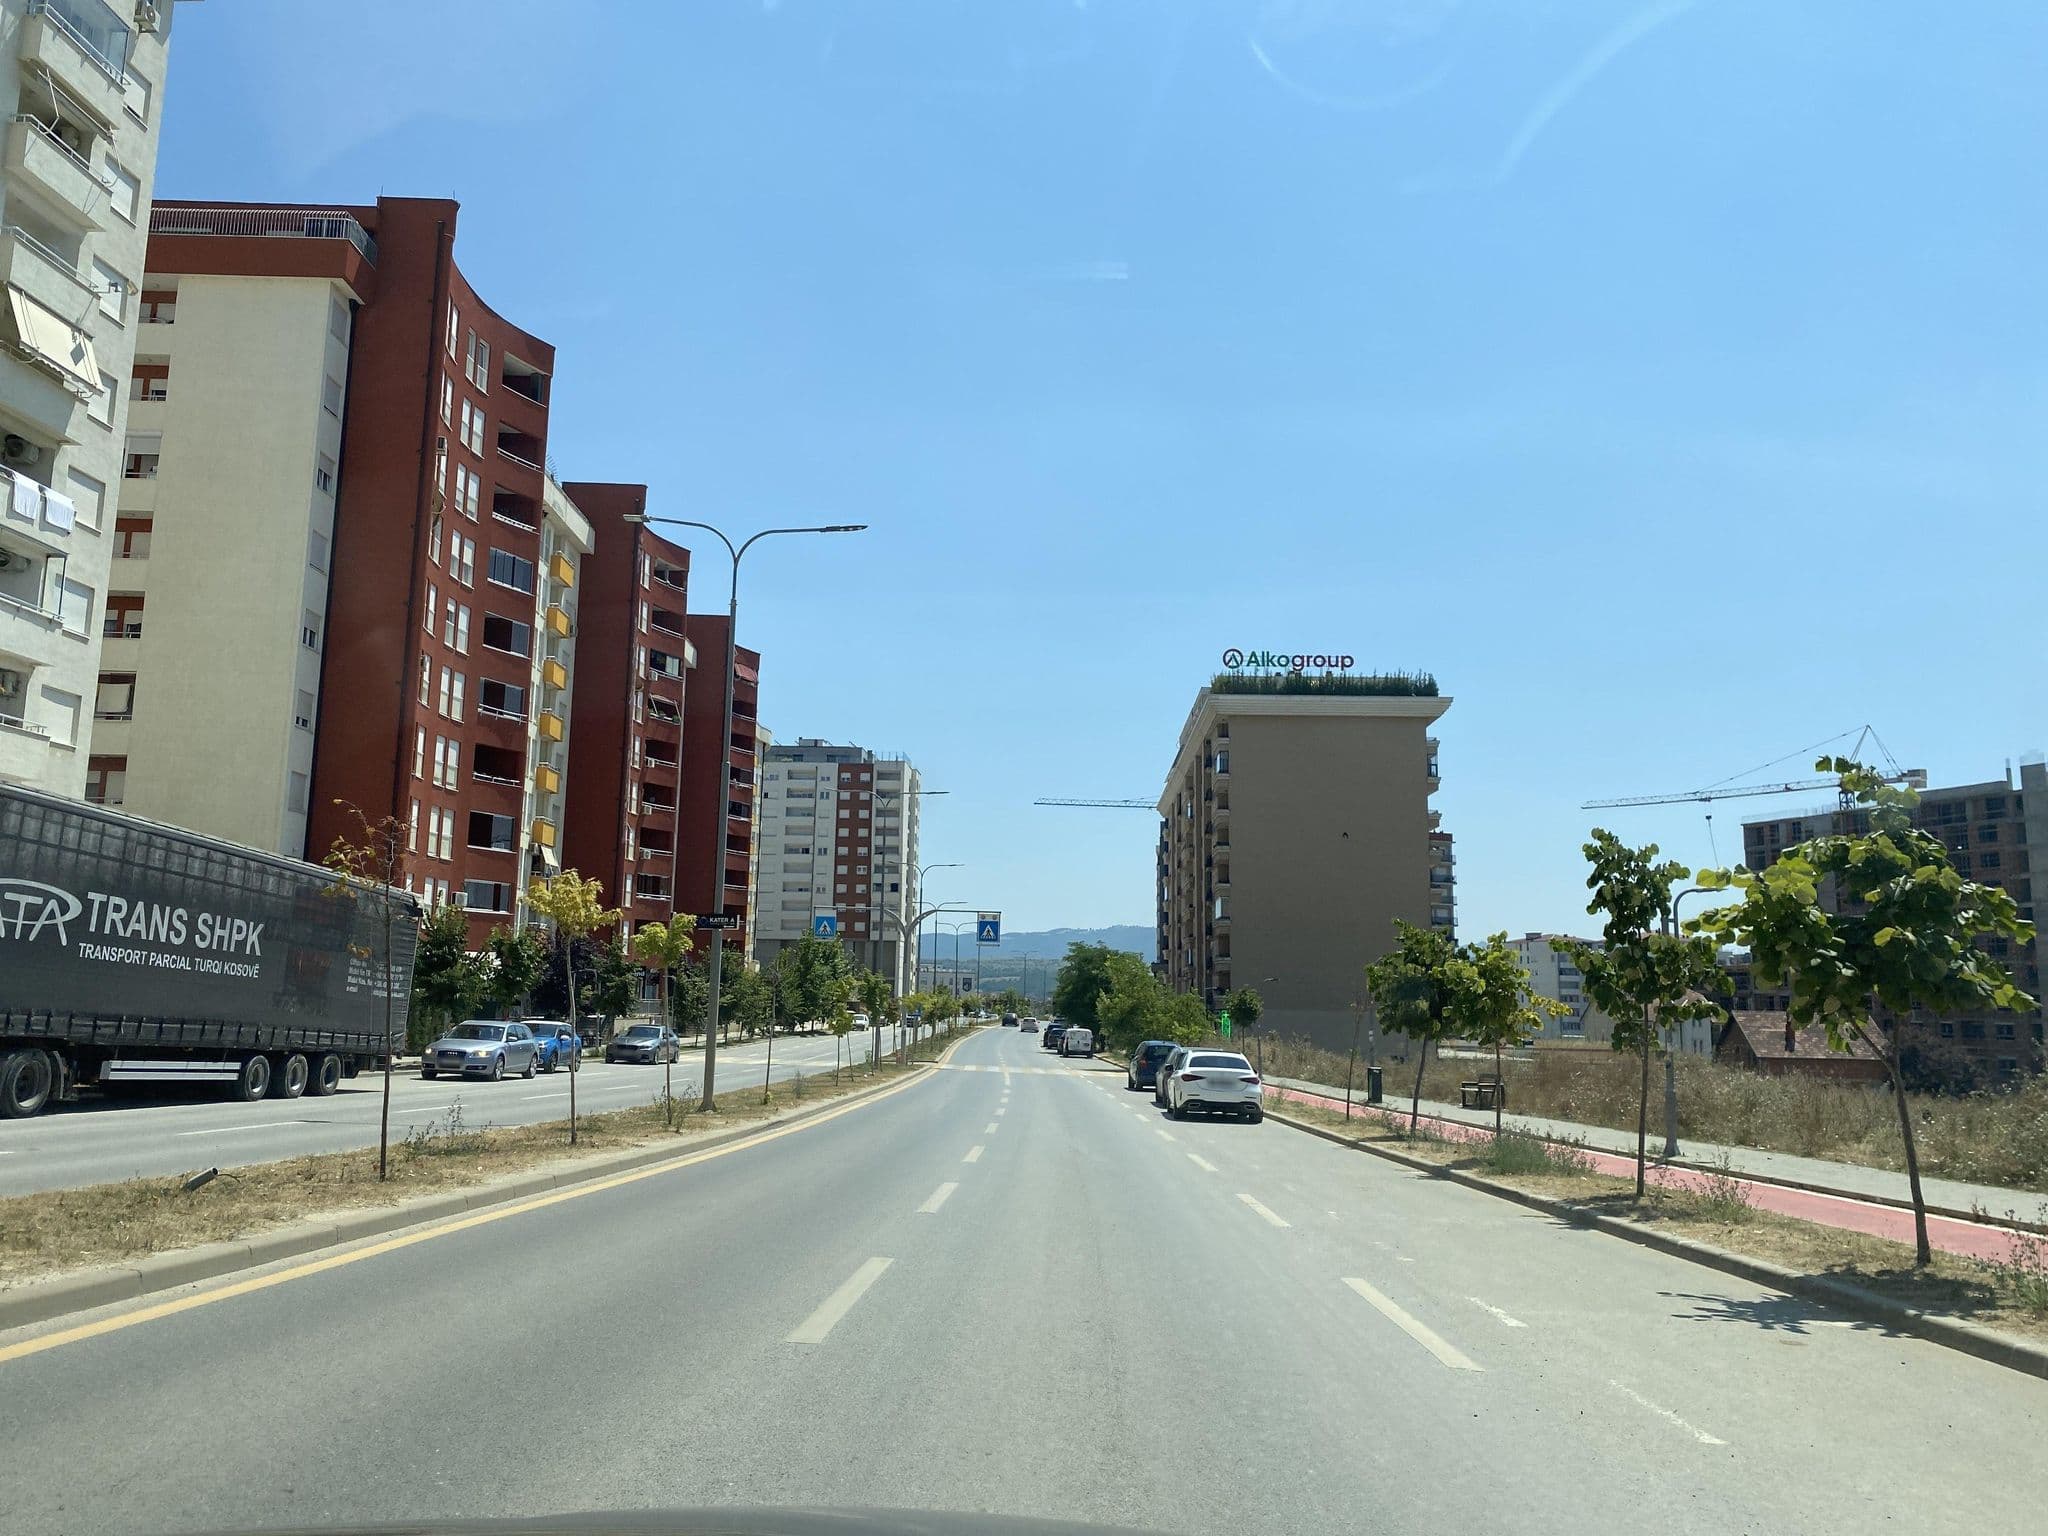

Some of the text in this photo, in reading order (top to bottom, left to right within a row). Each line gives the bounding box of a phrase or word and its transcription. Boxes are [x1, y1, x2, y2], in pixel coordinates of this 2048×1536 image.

[1246, 651, 1354, 671] Alkogroup
[0, 891, 68, 946] TA
[87, 891, 265, 957] TRANS SHPK
[78, 942, 148, 966] TRANSPORT
[149, 952, 192, 971] PARCIAL
[194, 958, 223, 975] TURQI
